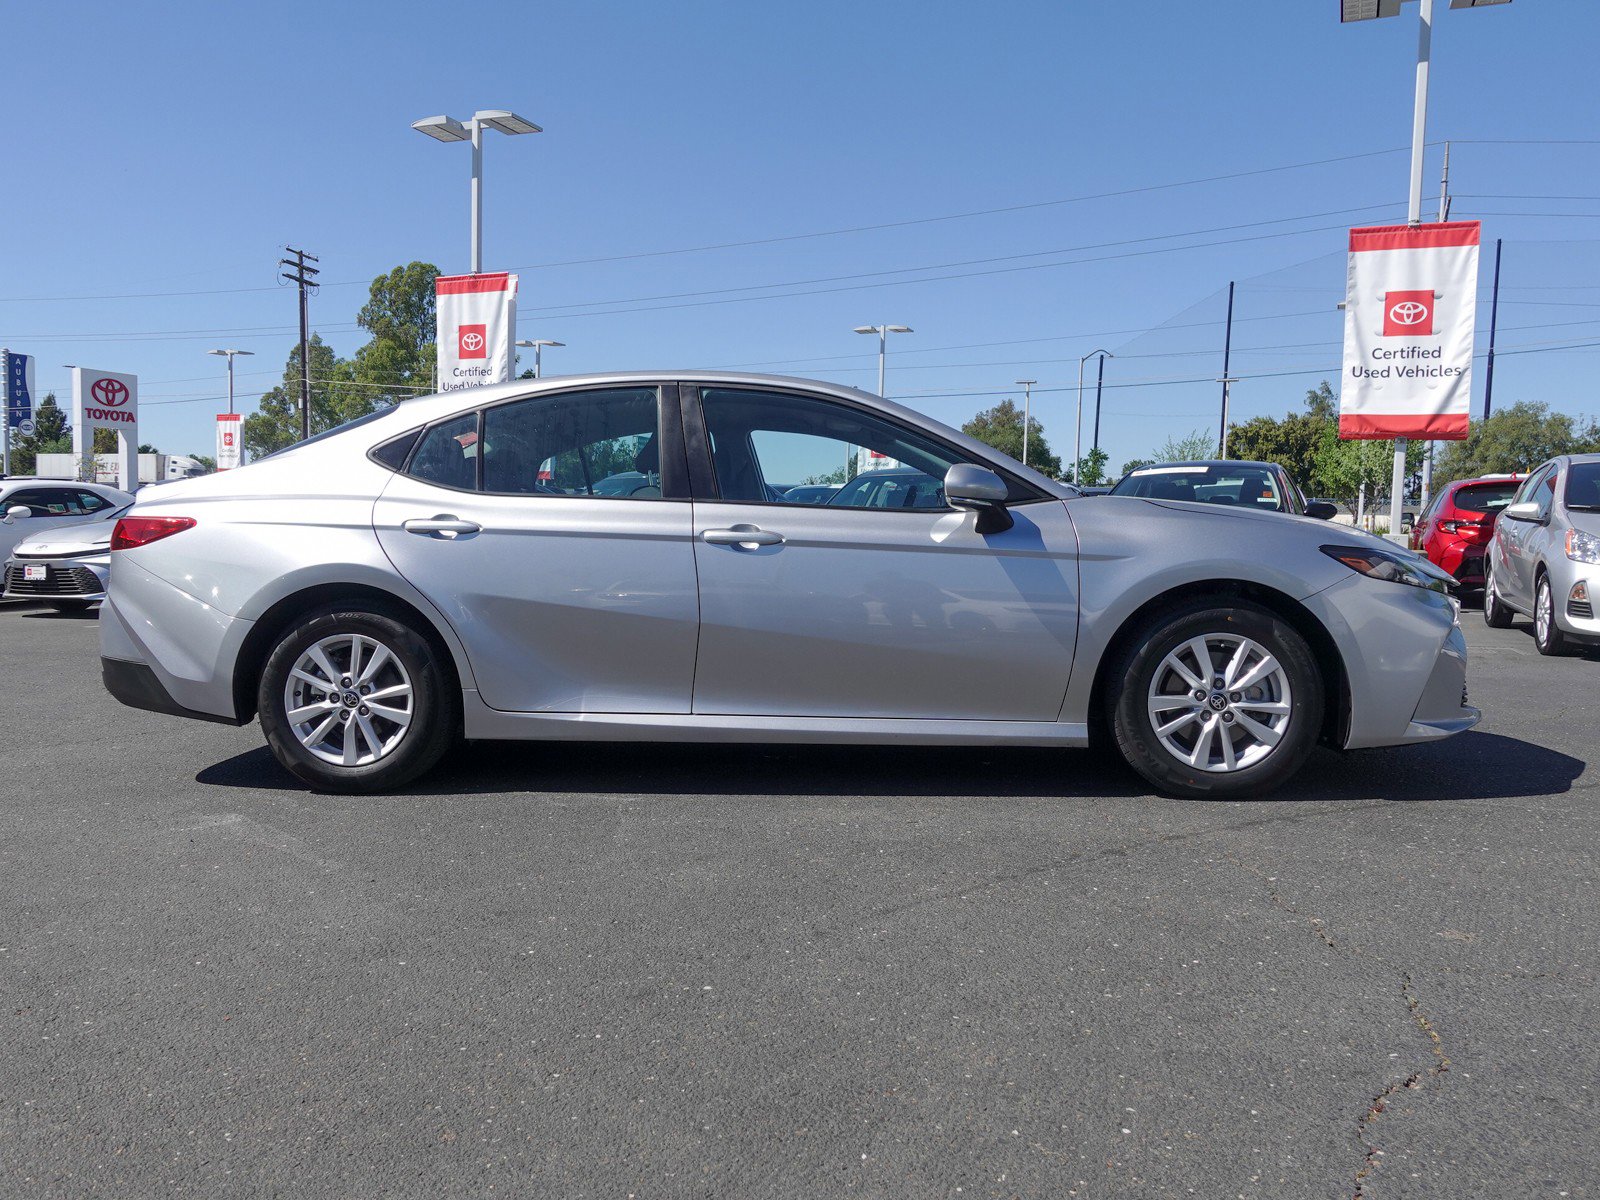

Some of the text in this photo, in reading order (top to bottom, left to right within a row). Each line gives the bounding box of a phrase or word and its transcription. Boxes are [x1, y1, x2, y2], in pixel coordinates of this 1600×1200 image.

[1371, 346, 1442, 360] Certified
[452, 366, 493, 377] Certified
[1351, 365, 1462, 379] Used Vehicles
[84, 407, 136, 423] TOYOTA
